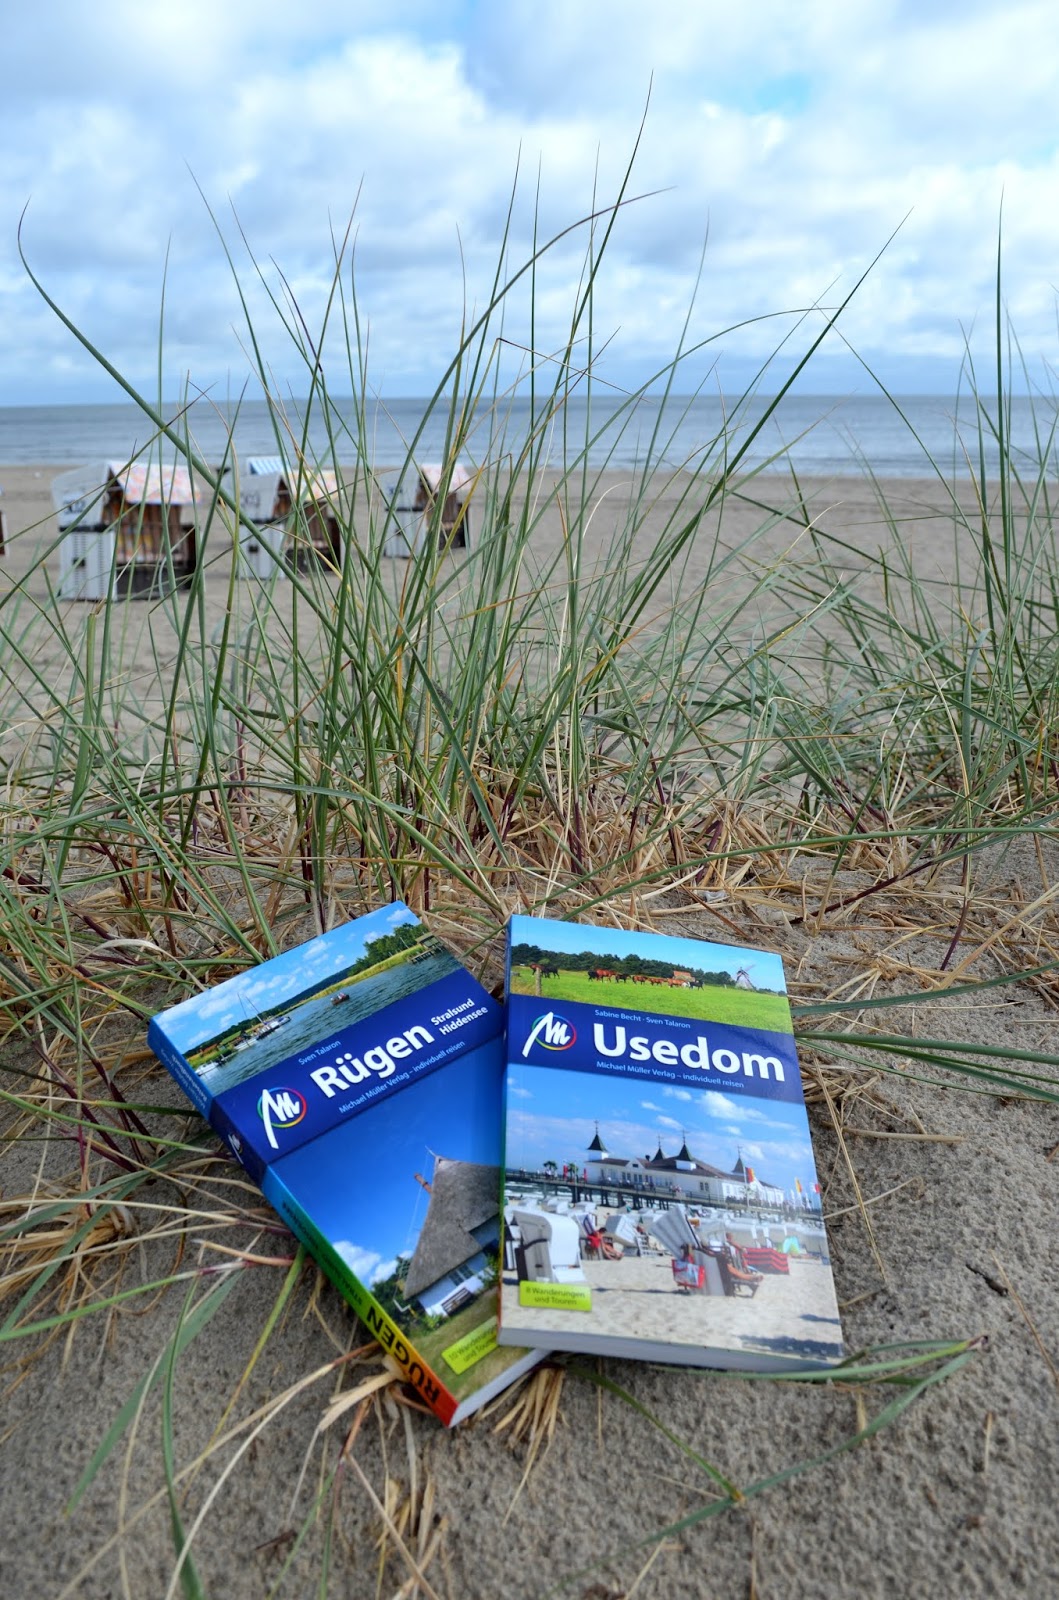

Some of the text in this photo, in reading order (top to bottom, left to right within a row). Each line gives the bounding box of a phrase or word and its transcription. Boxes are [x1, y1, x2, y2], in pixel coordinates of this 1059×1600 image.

[430, 998, 475, 1026] Stralsund
[439, 1006, 488, 1035] Hiddensee
[594, 1009, 619, 1019] Sabine
[620, 1013, 641, 1022] Becht
[646, 1016, 663, 1025] Sven
[665, 1019, 691, 1029] Talaron
[298, 1040, 342, 1066] Sven Talaron
[309, 1025, 435, 1099] Rügen
[593, 1023, 785, 1082] Usedom
[338, 1094, 367, 1113] Michael
[365, 1083, 388, 1099] Müller
[387, 1072, 410, 1087] Verlag
[413, 1050, 447, 1073] individuell
[445, 1041, 466, 1055] reisen
[596, 1061, 626, 1071] Michael
[627, 1065, 650, 1075] Müller
[652, 1069, 676, 1080] Verlag
[682, 1073, 721, 1085] individuell
[722, 1080, 745, 1088] reisen
